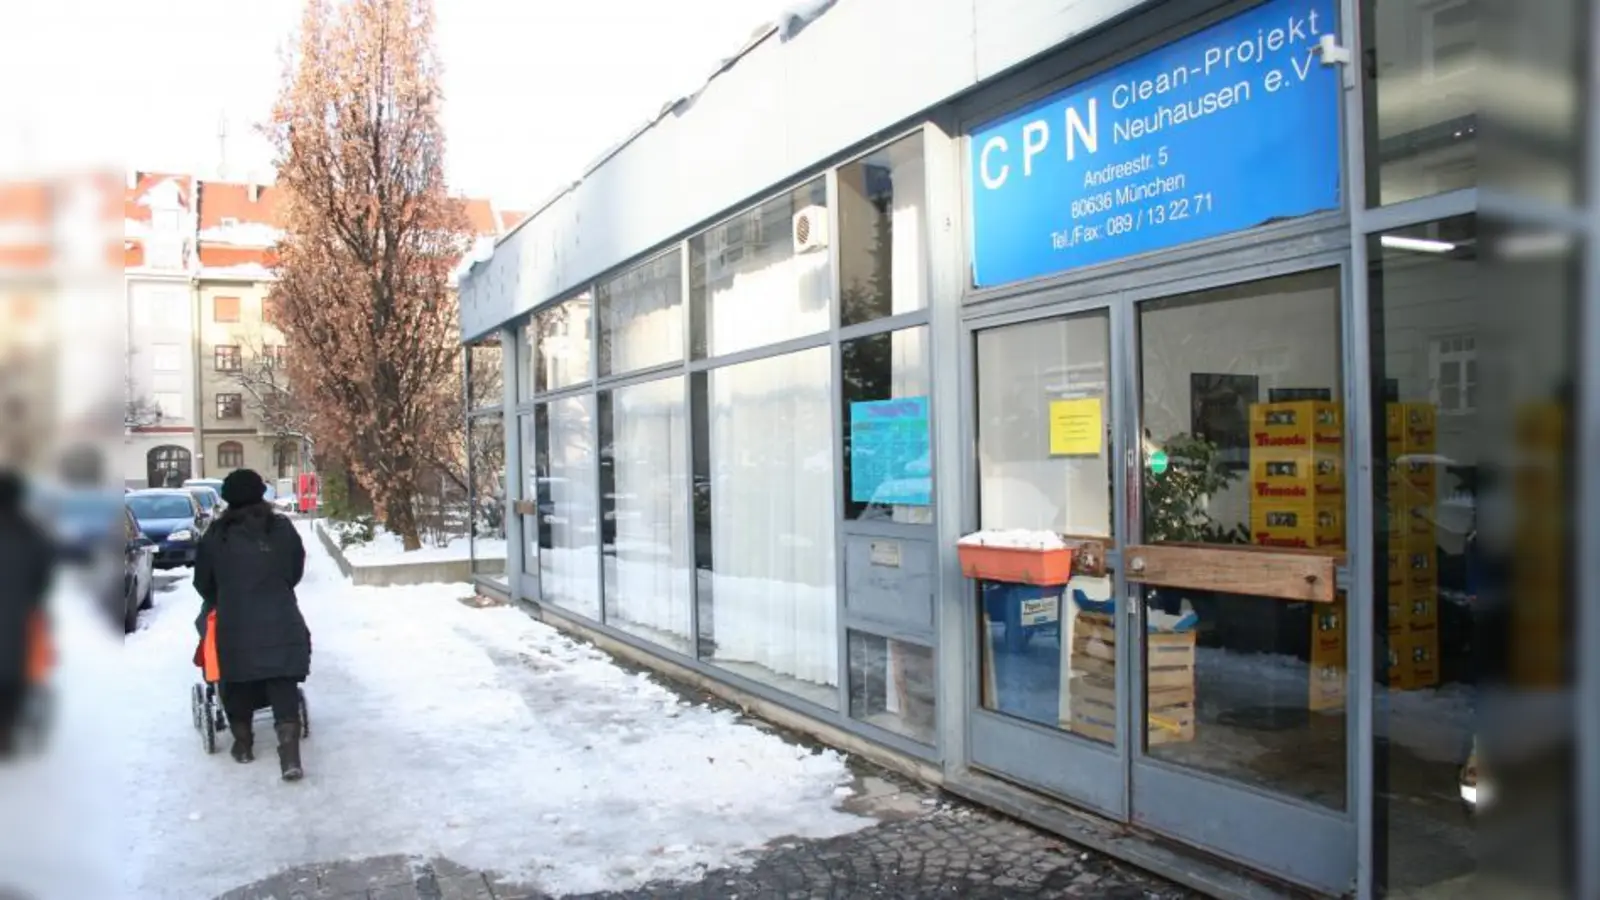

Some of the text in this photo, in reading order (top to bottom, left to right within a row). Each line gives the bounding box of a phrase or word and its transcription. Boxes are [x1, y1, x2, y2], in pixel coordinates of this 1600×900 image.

[1111, 9, 1320, 110] Clean-Projekt
[1112, 80, 1250, 144] Neuhausen
[1084, 146, 1169, 189] Andreestr. 5
[1071, 173, 1185, 219] 80636 München
[1106, 213, 1133, 237] 089
[1136, 209, 1144, 230] /
[1148, 205, 1165, 225] 13
[1169, 198, 1190, 221] 22
[1193, 192, 1213, 214] 71
